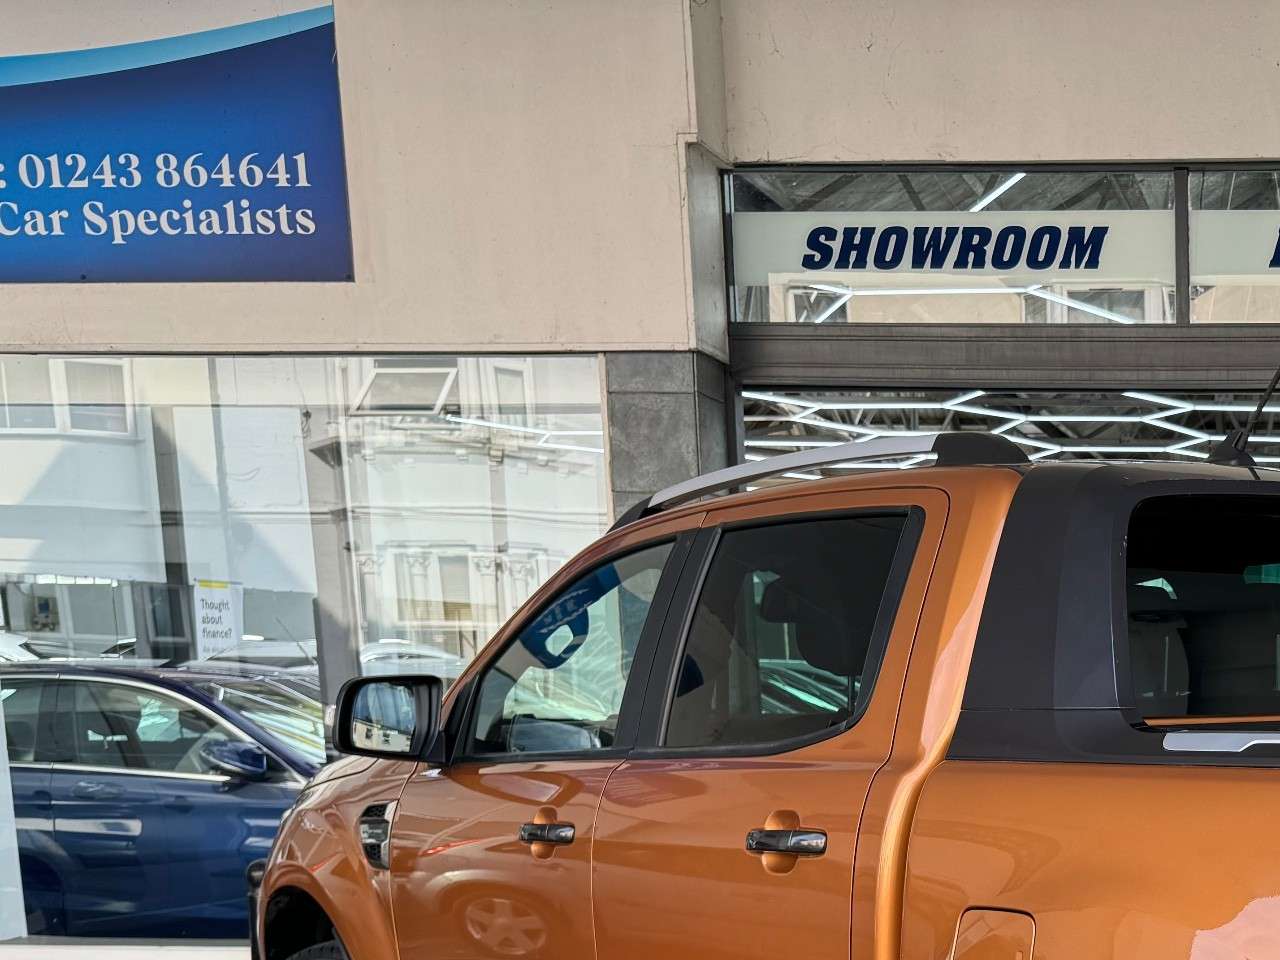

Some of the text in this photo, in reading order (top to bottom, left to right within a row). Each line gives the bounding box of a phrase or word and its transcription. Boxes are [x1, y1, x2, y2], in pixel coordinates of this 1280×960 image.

[18, 152, 142, 189] 01243
[155, 152, 312, 188] 864641
[0, 199, 316, 244] Car Specialists
[802, 225, 1109, 271] SHOWROOM
[200, 598, 230, 613] Thought
[201, 614, 223, 625] about
[202, 628, 232, 640] finance?
